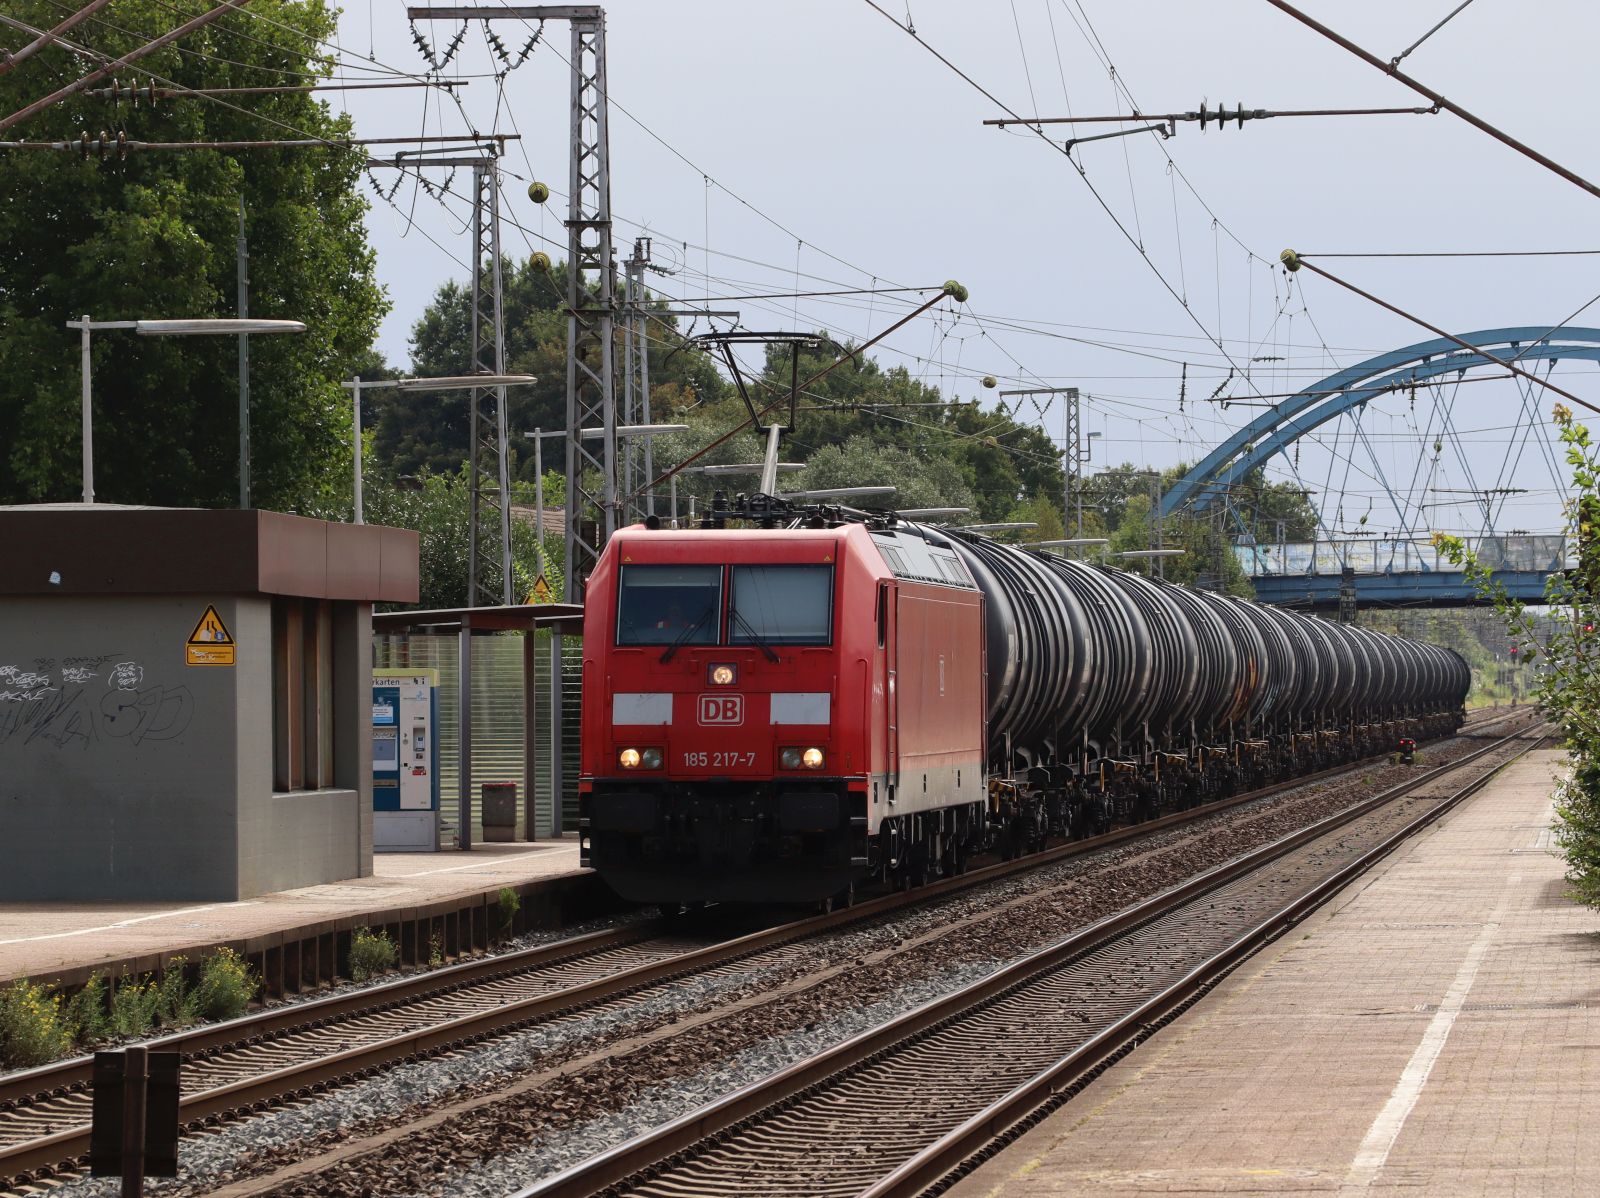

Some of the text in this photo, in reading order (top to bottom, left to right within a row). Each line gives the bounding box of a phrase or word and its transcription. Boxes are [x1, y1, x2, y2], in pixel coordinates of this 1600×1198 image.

[703, 698, 739, 721] DB
[683, 752, 756, 767] 185 217-7
